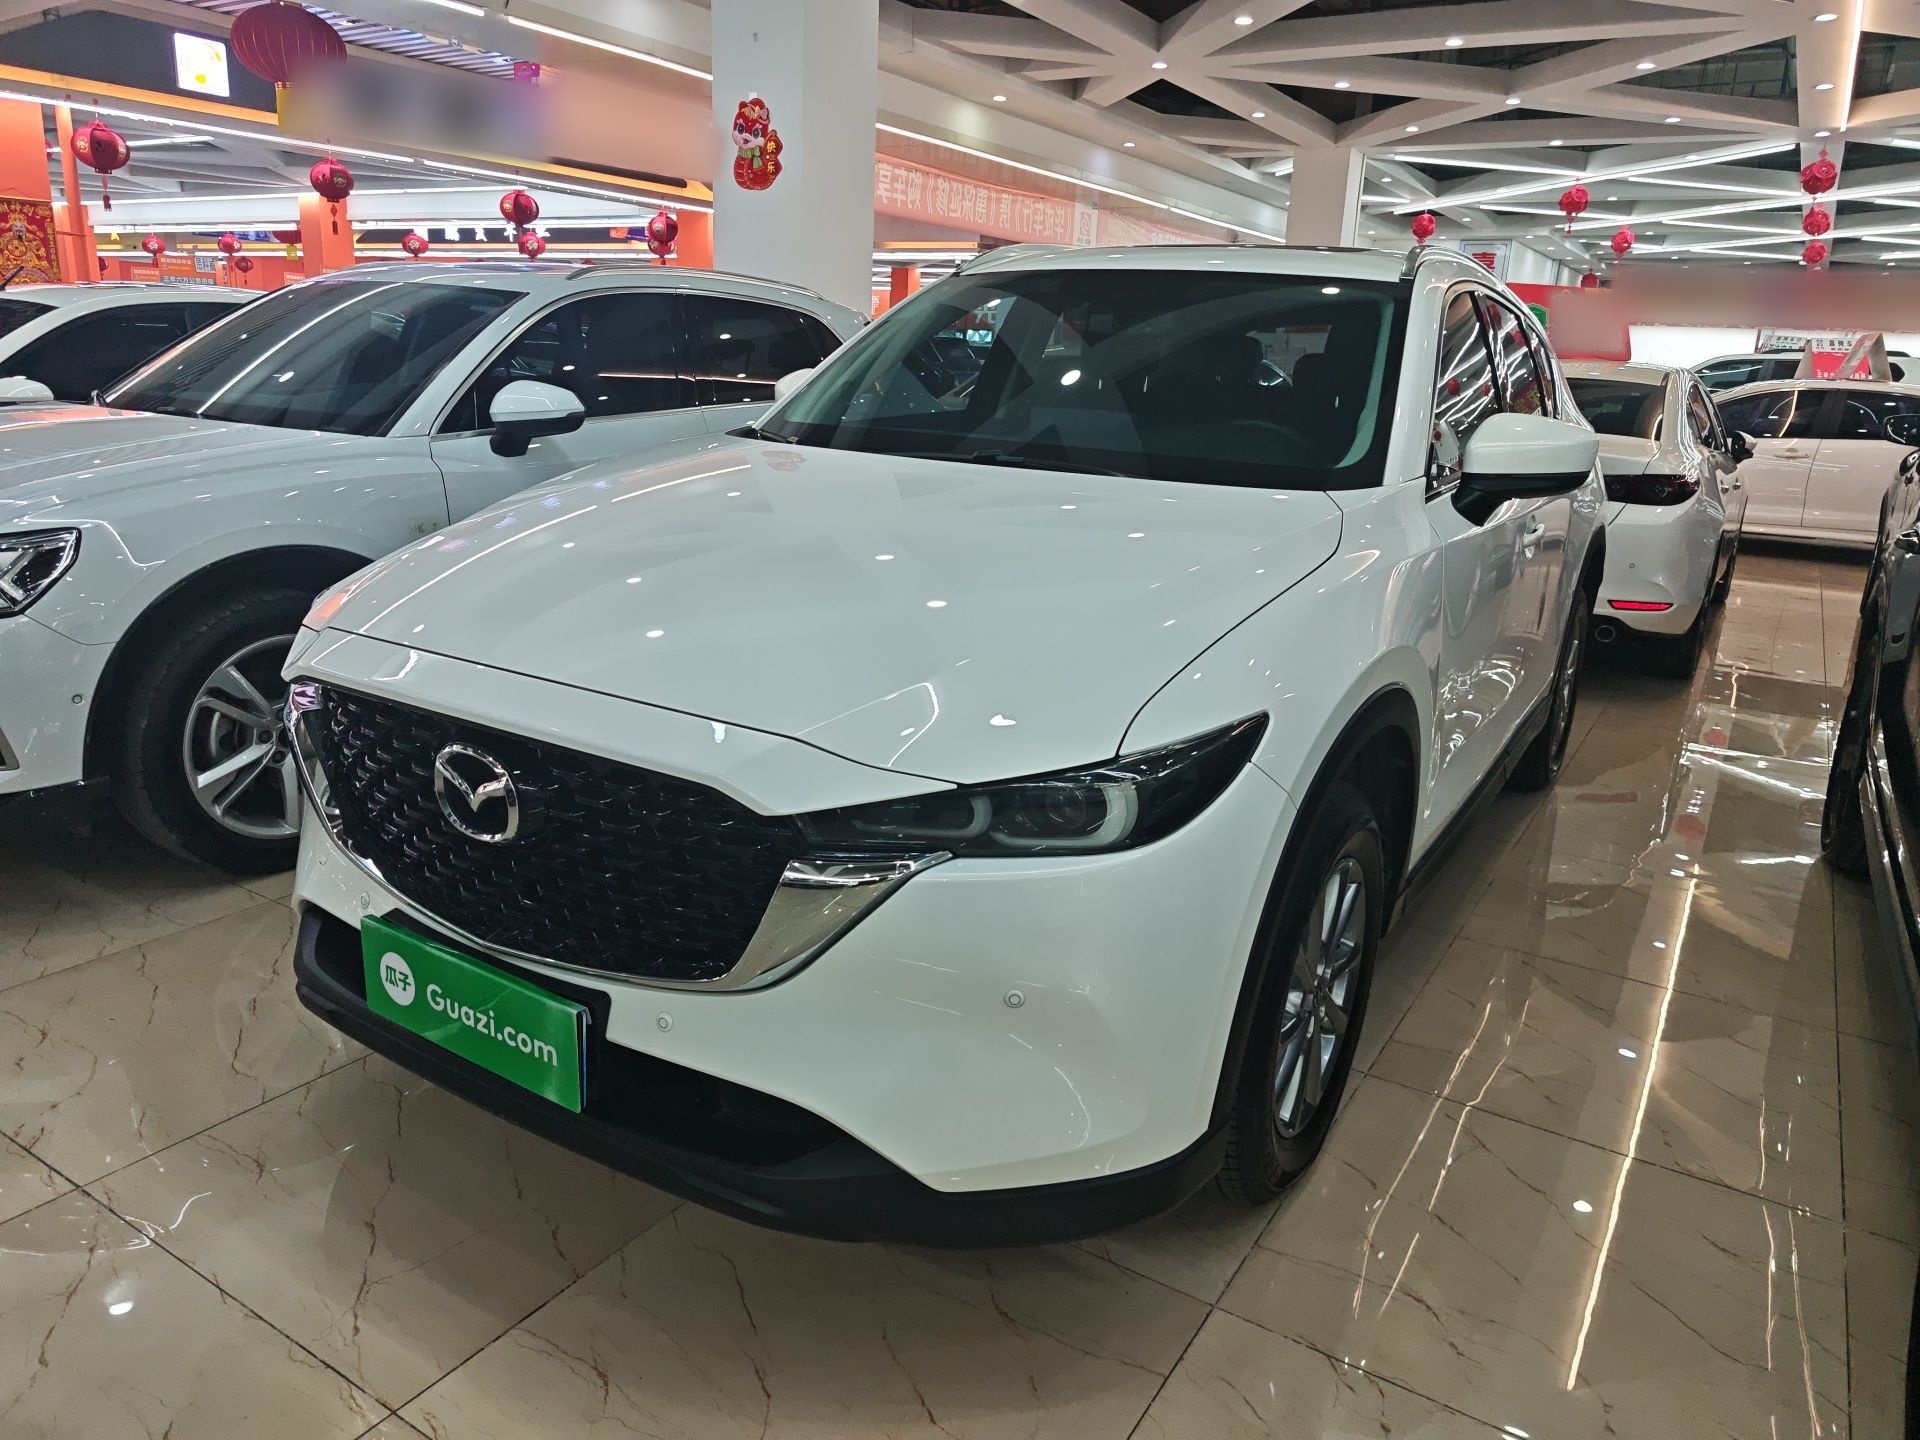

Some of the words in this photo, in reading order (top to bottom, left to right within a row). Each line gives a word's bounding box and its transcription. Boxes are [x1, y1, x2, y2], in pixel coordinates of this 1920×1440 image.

[766, 141, 777, 174] 快乐
[385, 964, 411, 992] 瓜子
[426, 983, 558, 1067] Guazi.com
